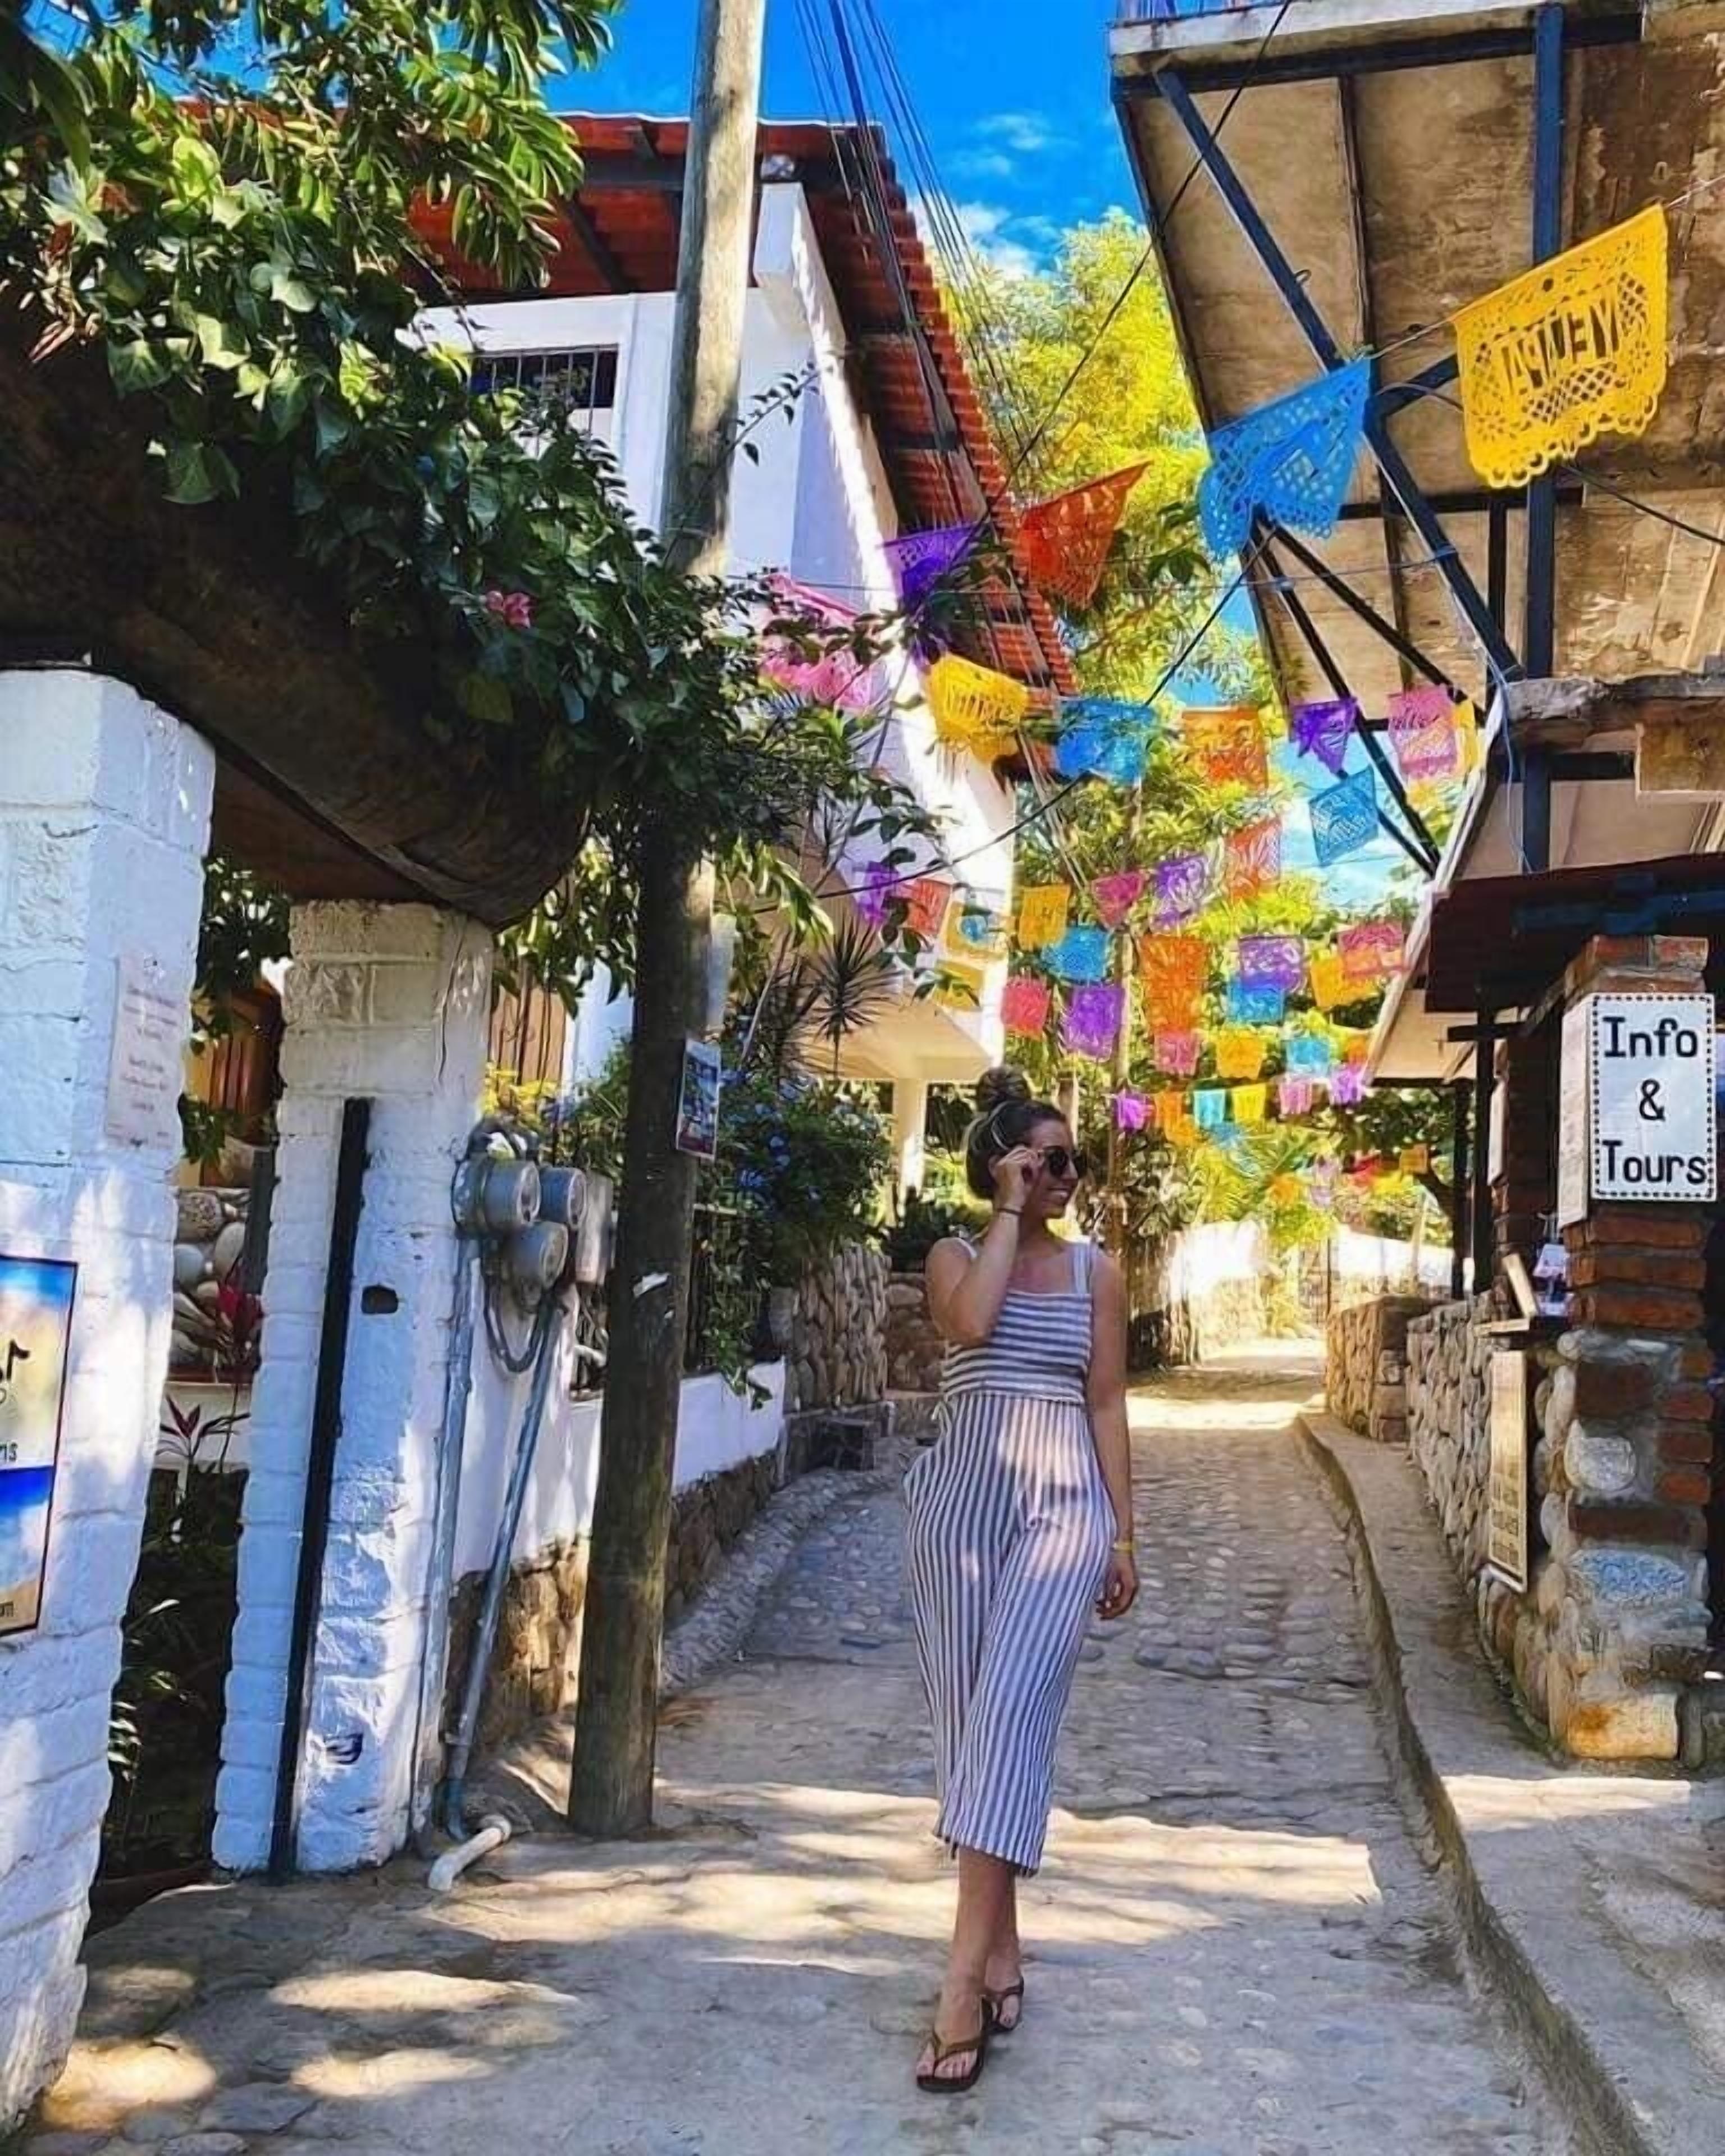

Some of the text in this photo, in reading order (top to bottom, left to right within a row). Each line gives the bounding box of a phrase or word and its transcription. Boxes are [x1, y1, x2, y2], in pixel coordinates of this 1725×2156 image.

[1602, 1016, 1698, 1057] Info
[1639, 1079, 1665, 1121] &
[1602, 1140, 1707, 1185] Tours
